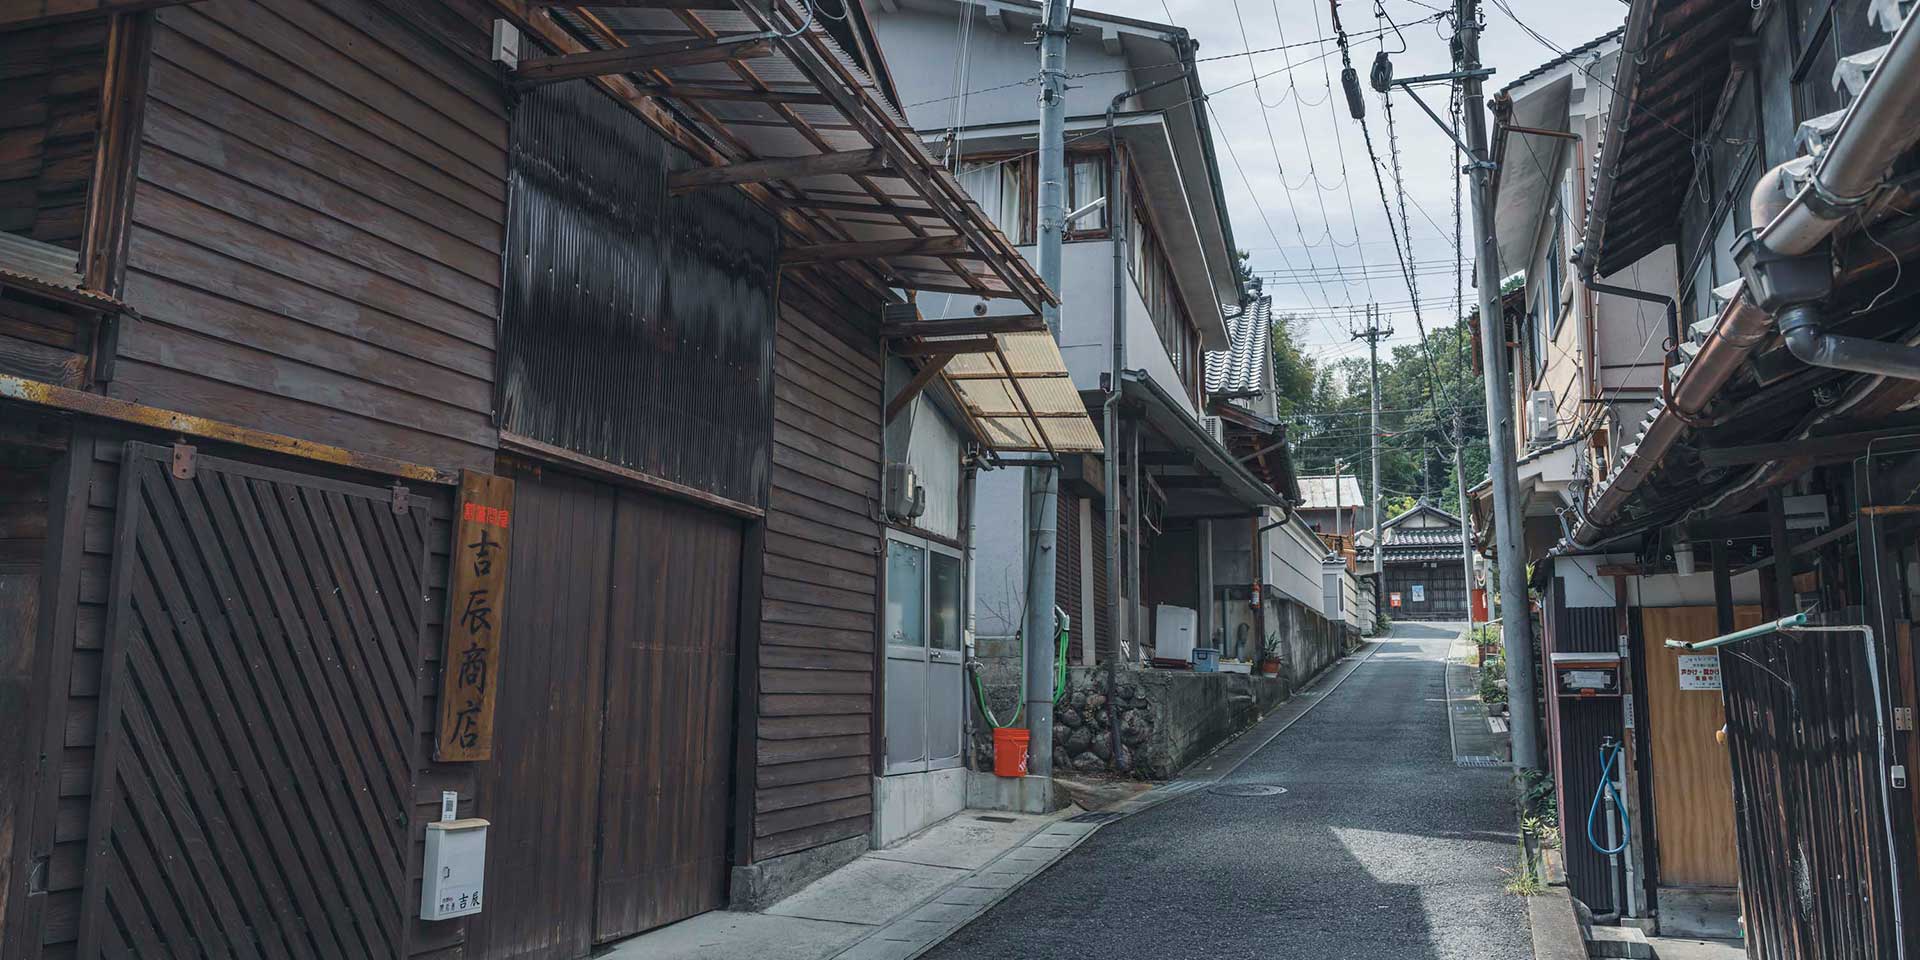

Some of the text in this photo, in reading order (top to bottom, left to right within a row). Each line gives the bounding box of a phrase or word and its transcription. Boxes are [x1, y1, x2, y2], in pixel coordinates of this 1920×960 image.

[449, 529, 502, 748] 吉辰商店
[459, 891, 480, 909] 吉辰
